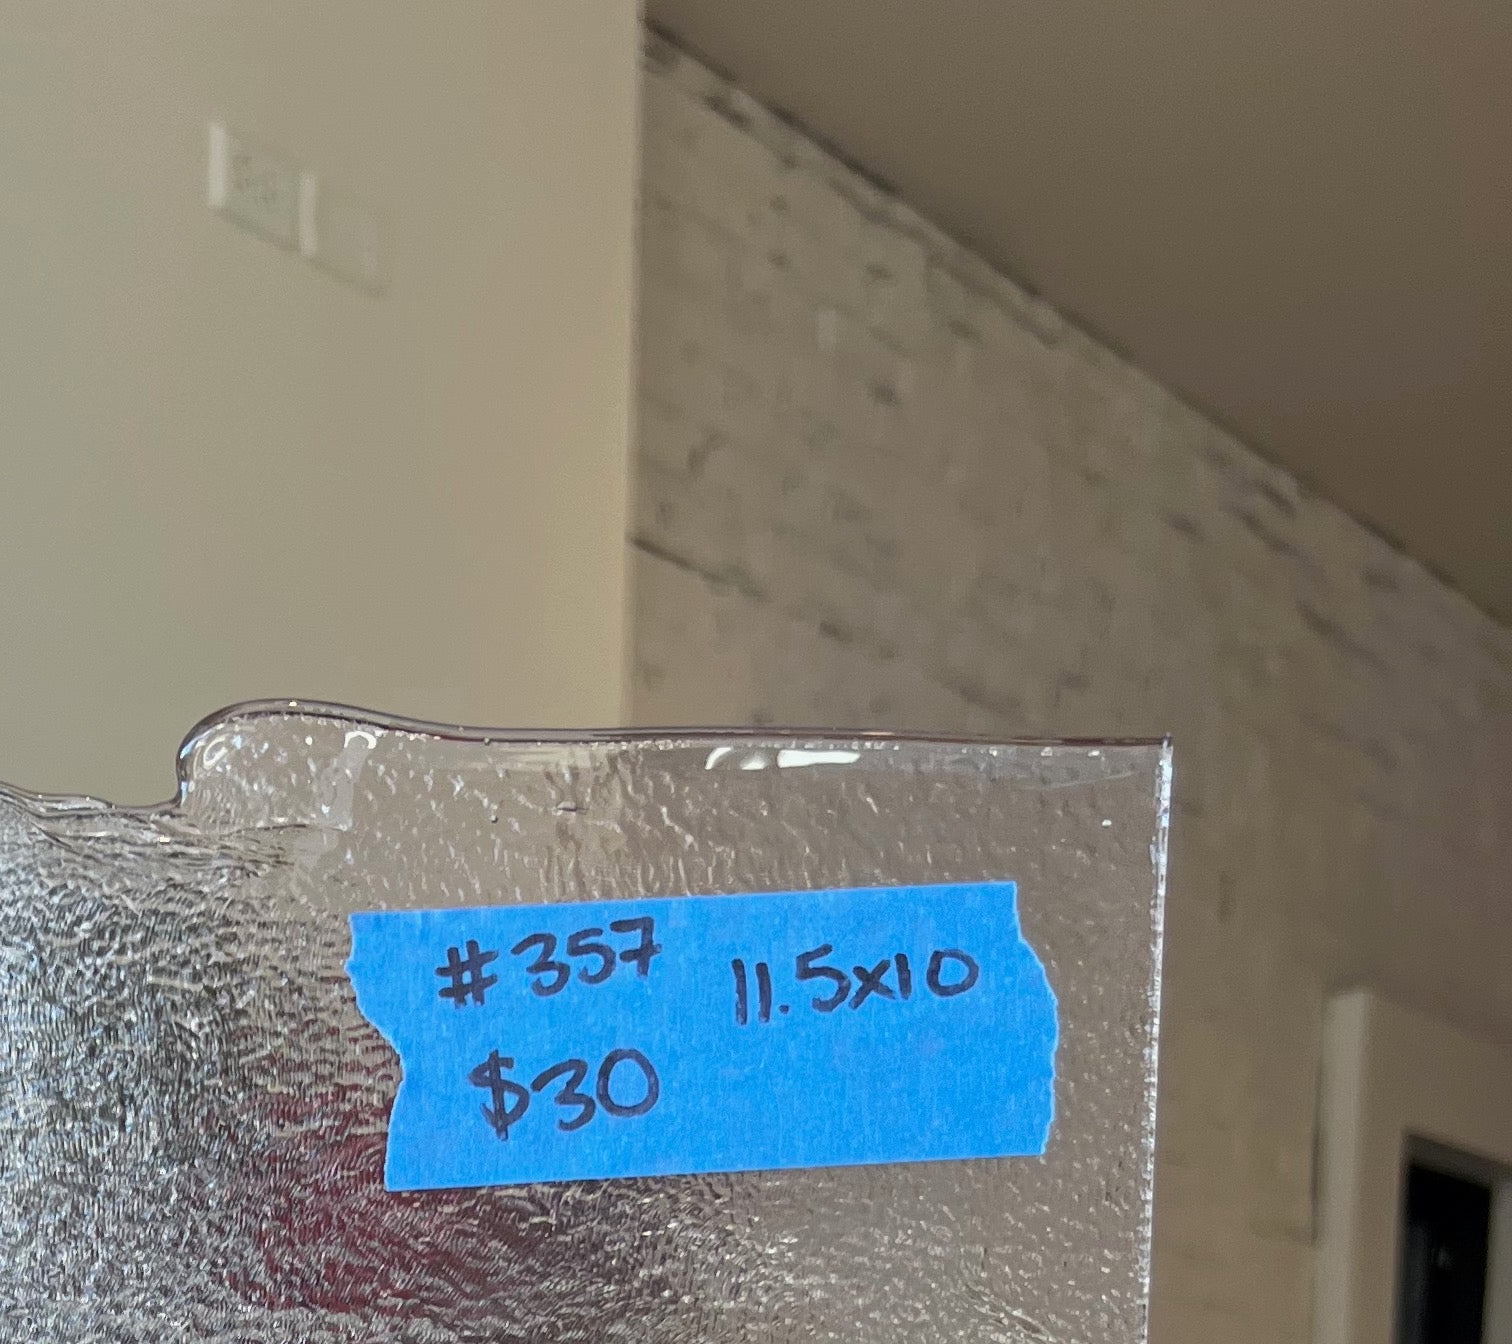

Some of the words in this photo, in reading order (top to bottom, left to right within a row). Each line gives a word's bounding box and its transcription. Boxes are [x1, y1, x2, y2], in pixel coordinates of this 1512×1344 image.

[434, 915, 663, 1007] #357
[731, 943, 980, 1026] 11.5x10
[467, 1048, 660, 1141] $30
